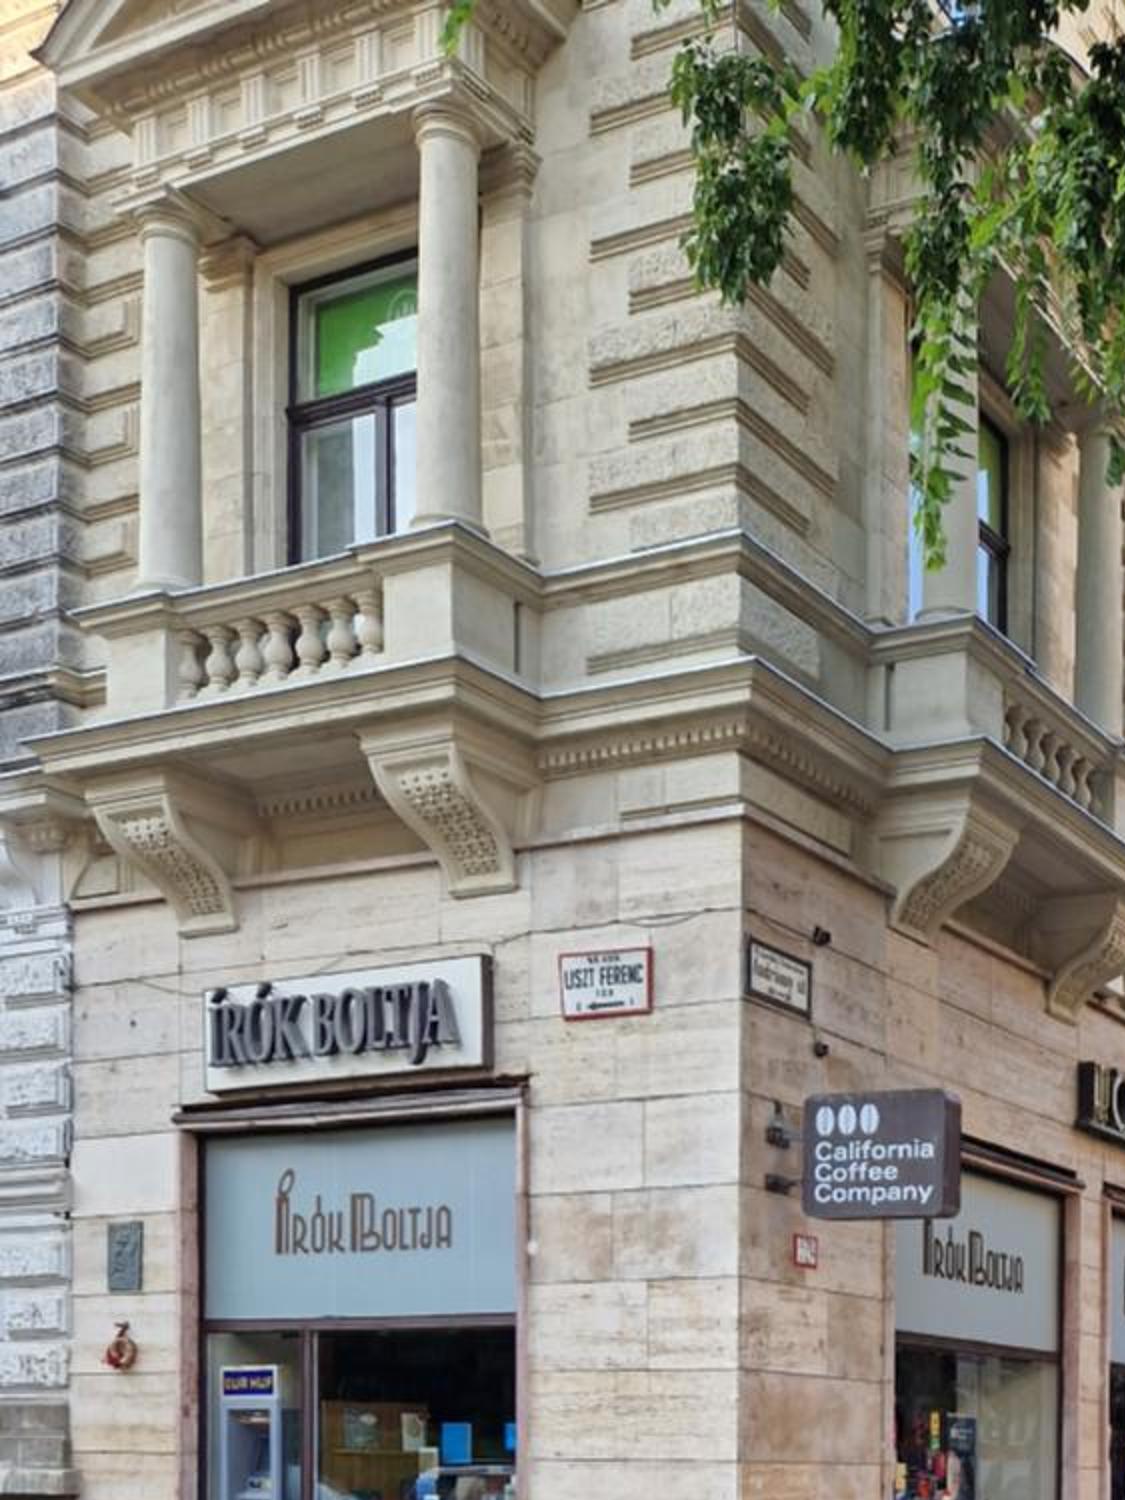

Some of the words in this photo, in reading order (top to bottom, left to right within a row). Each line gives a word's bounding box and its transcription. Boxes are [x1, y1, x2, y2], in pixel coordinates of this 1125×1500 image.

[599, 964, 643, 986] FERENC
[208, 983, 313, 1068] ÍRÓK
[310, 977, 464, 1066] BOLTJA
[815, 1138, 935, 1161] California
[814, 1162, 898, 1182] Coffee
[814, 1183, 934, 1205] Company
